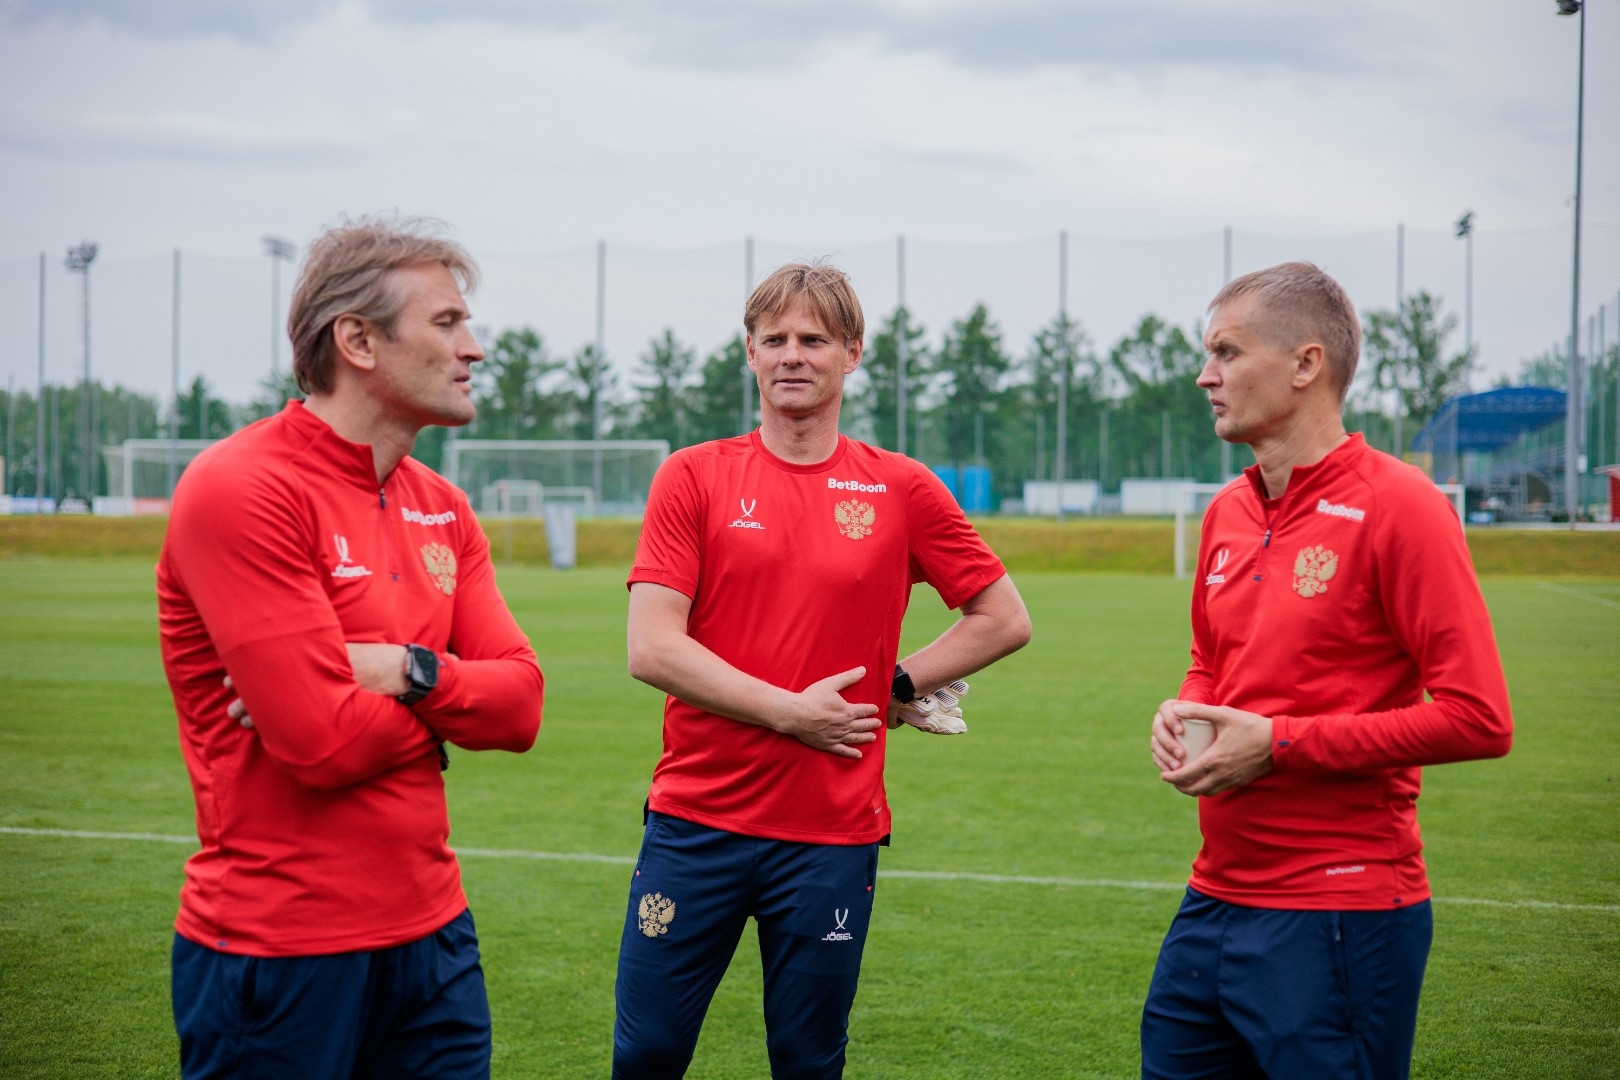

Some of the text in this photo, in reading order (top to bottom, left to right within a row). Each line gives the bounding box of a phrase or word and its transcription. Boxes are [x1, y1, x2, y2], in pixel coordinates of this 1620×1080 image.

[827, 477, 887, 493] BetBoom
[728, 518, 766, 530] JÖGEL
[821, 931, 854, 941] JÖGEL
